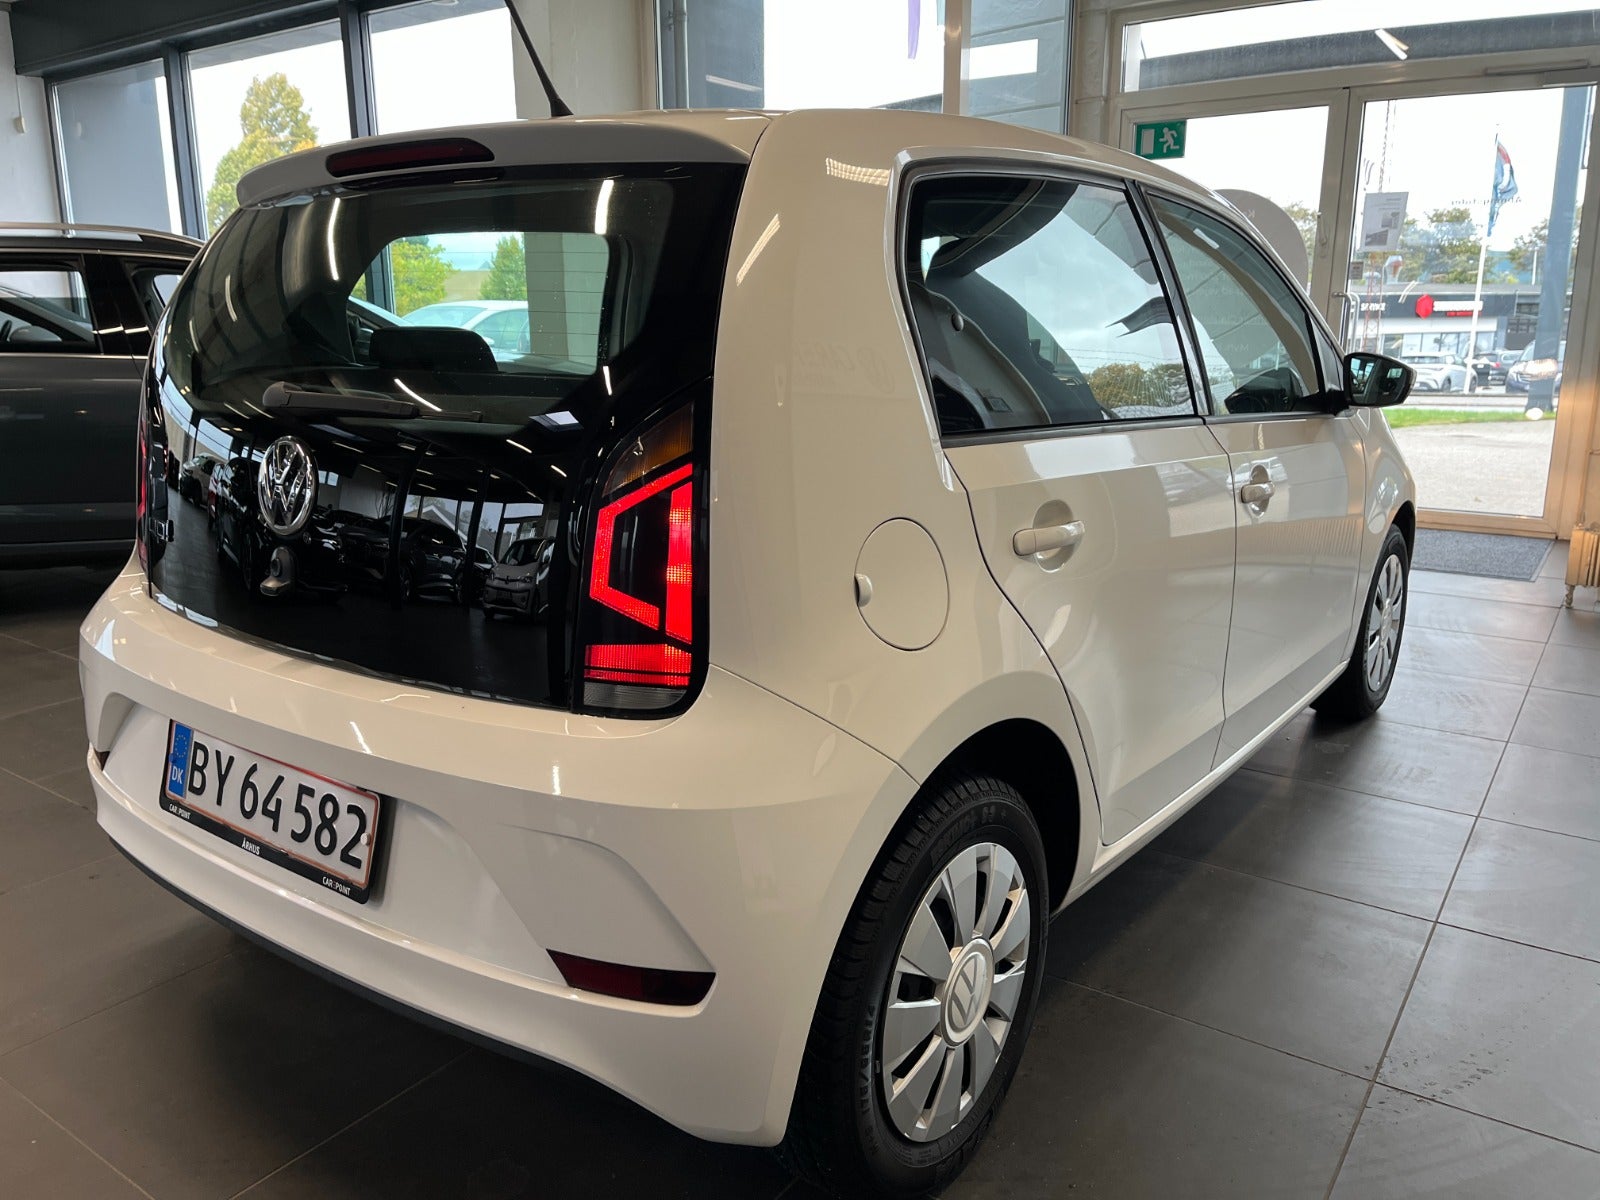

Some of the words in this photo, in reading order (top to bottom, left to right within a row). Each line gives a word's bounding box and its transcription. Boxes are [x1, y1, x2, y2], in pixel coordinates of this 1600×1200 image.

[171, 765, 184, 785] DK
[187, 740, 236, 807] BY
[239, 762, 286, 833] 64
[290, 782, 368, 870] 582
[241, 837, 262, 856] ÅRHUS
